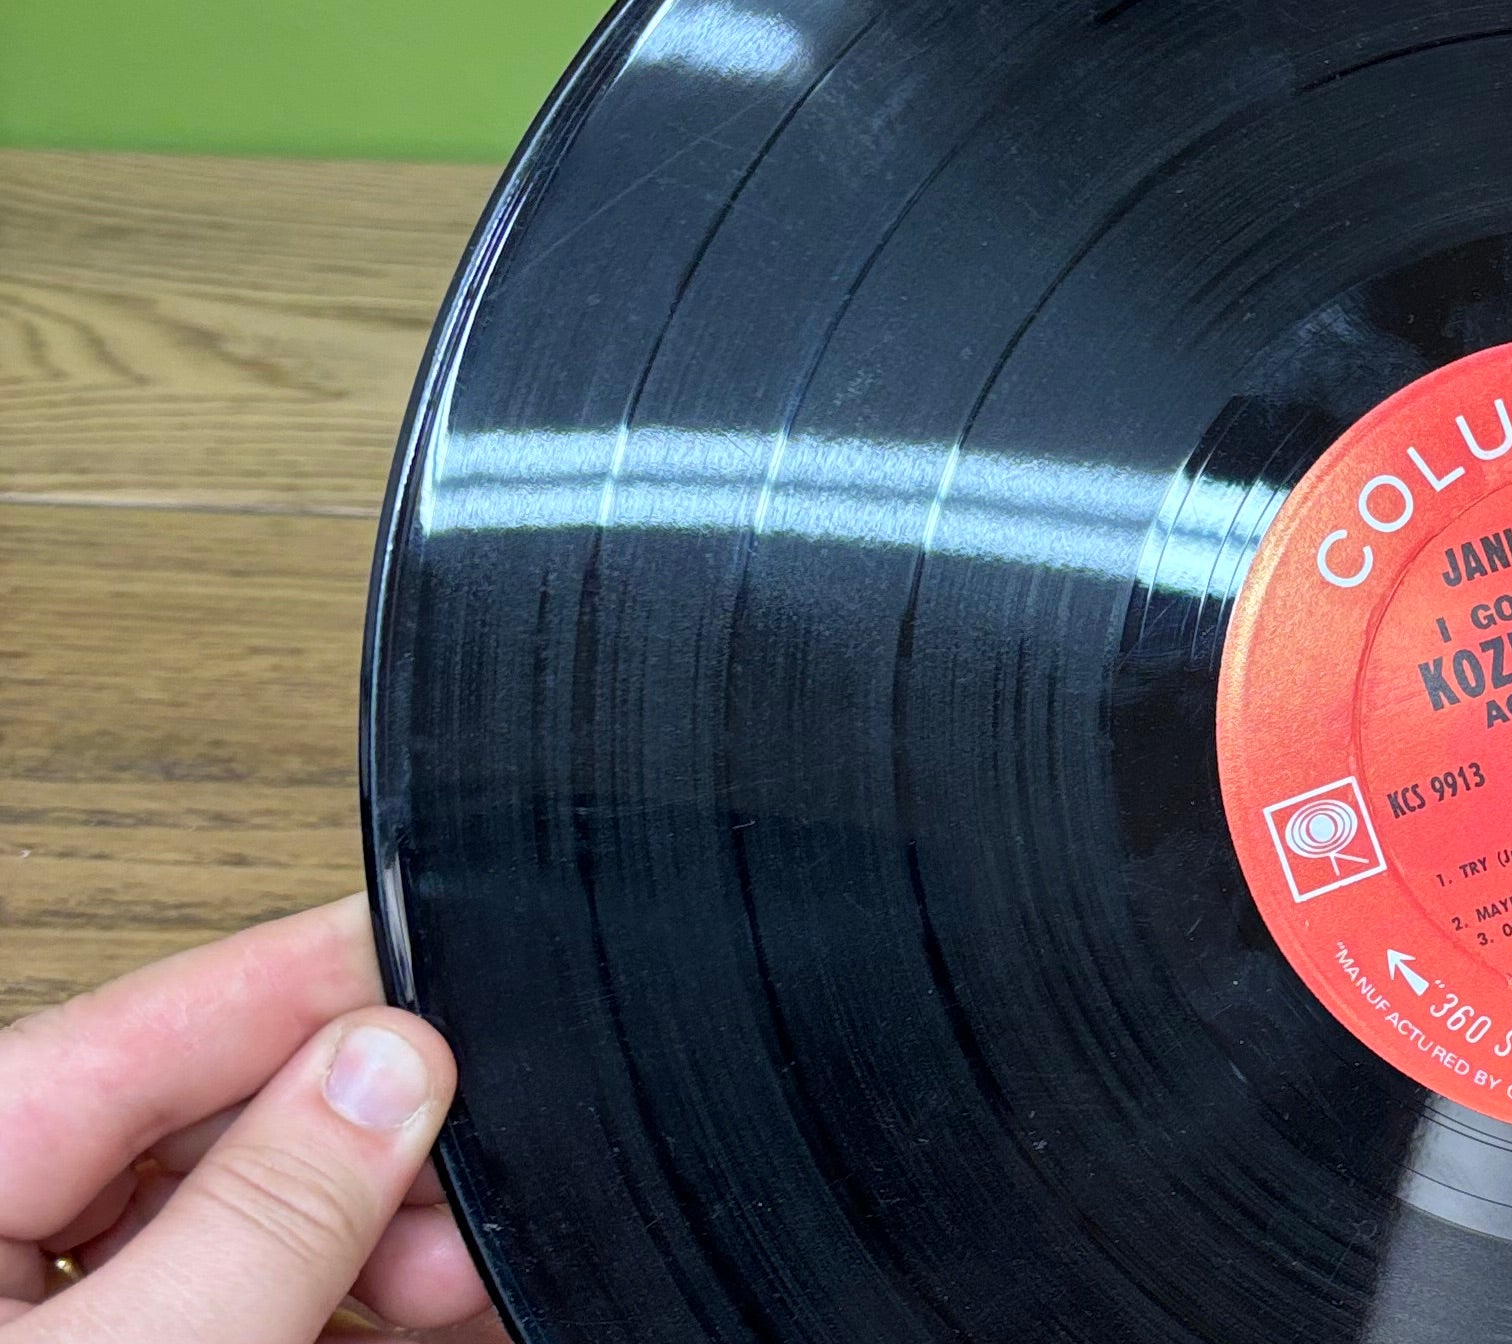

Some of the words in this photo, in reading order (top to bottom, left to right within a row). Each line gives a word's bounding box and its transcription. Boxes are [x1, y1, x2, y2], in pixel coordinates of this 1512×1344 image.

[1436, 617, 1452, 643] I
[1387, 783, 1426, 819] KCS
[1430, 762, 1486, 802] 9913
[1436, 874, 1453, 887] 1.
[1459, 857, 1488, 878] TRY
[1451, 916, 1468, 931] 2.
[1477, 932, 1494, 946] 3.
[1474, 1069, 1502, 1089] BY
